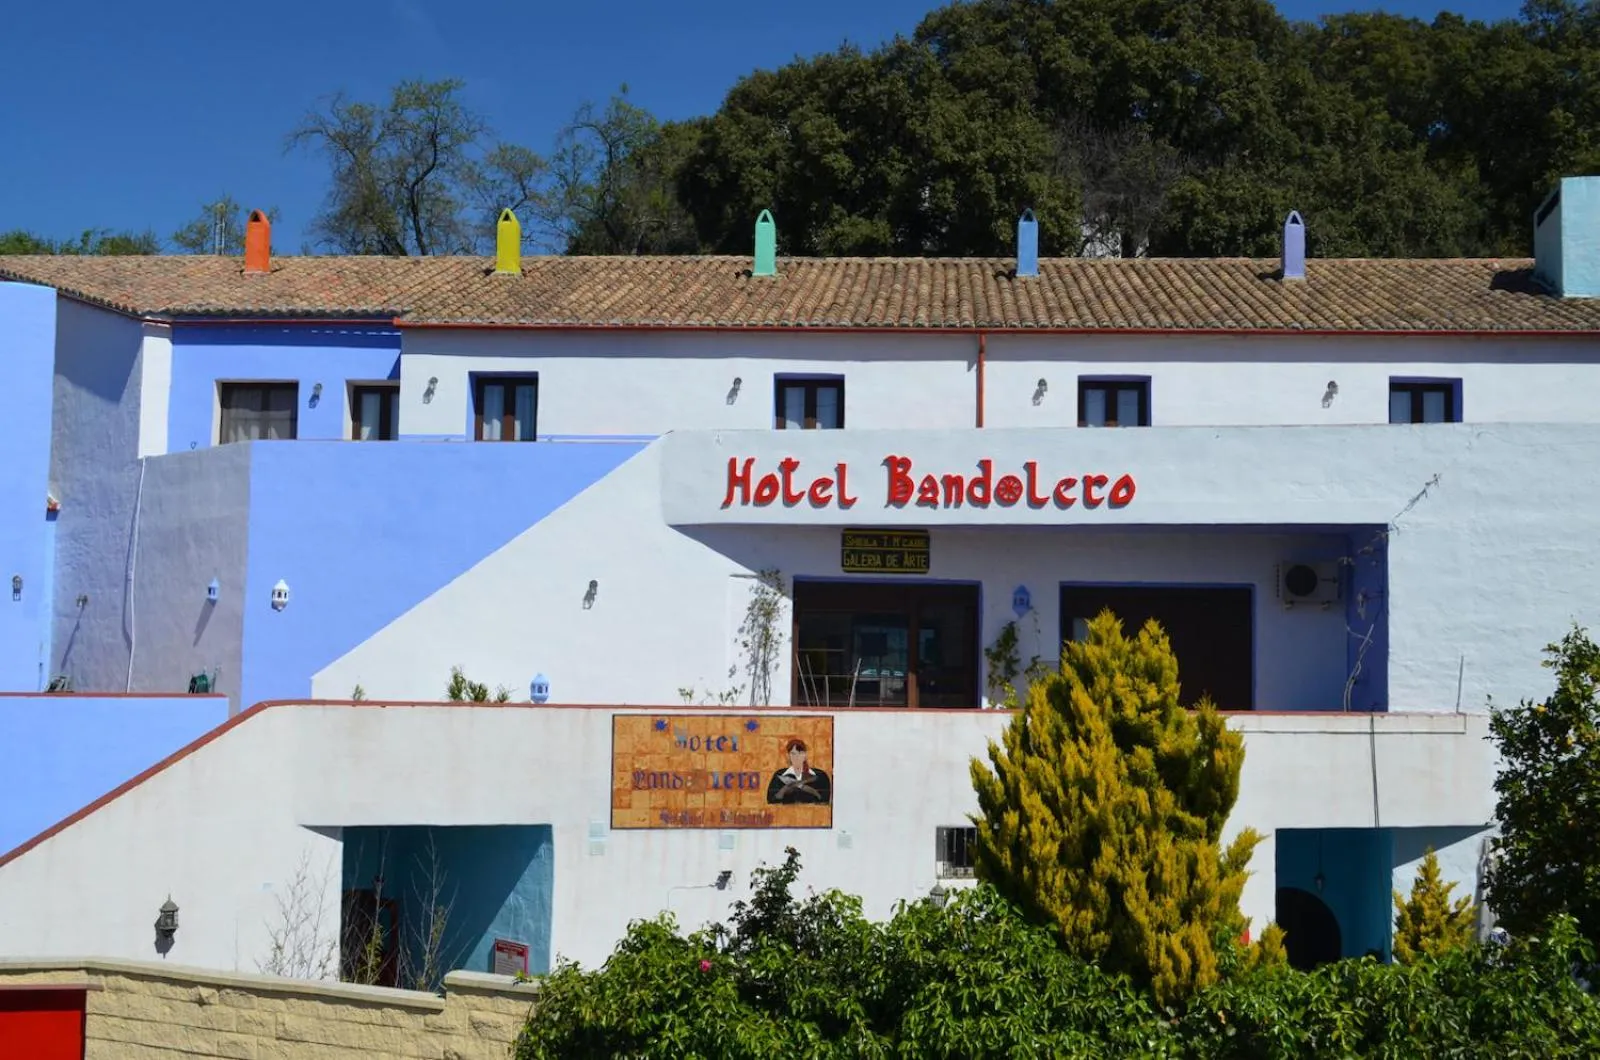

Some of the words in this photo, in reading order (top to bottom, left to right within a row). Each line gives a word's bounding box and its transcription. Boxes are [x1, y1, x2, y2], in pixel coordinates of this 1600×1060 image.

[723, 457, 857, 506] Hotel
[885, 455, 1136, 506] Bandolero
[632, 769, 760, 791] Bandlero
